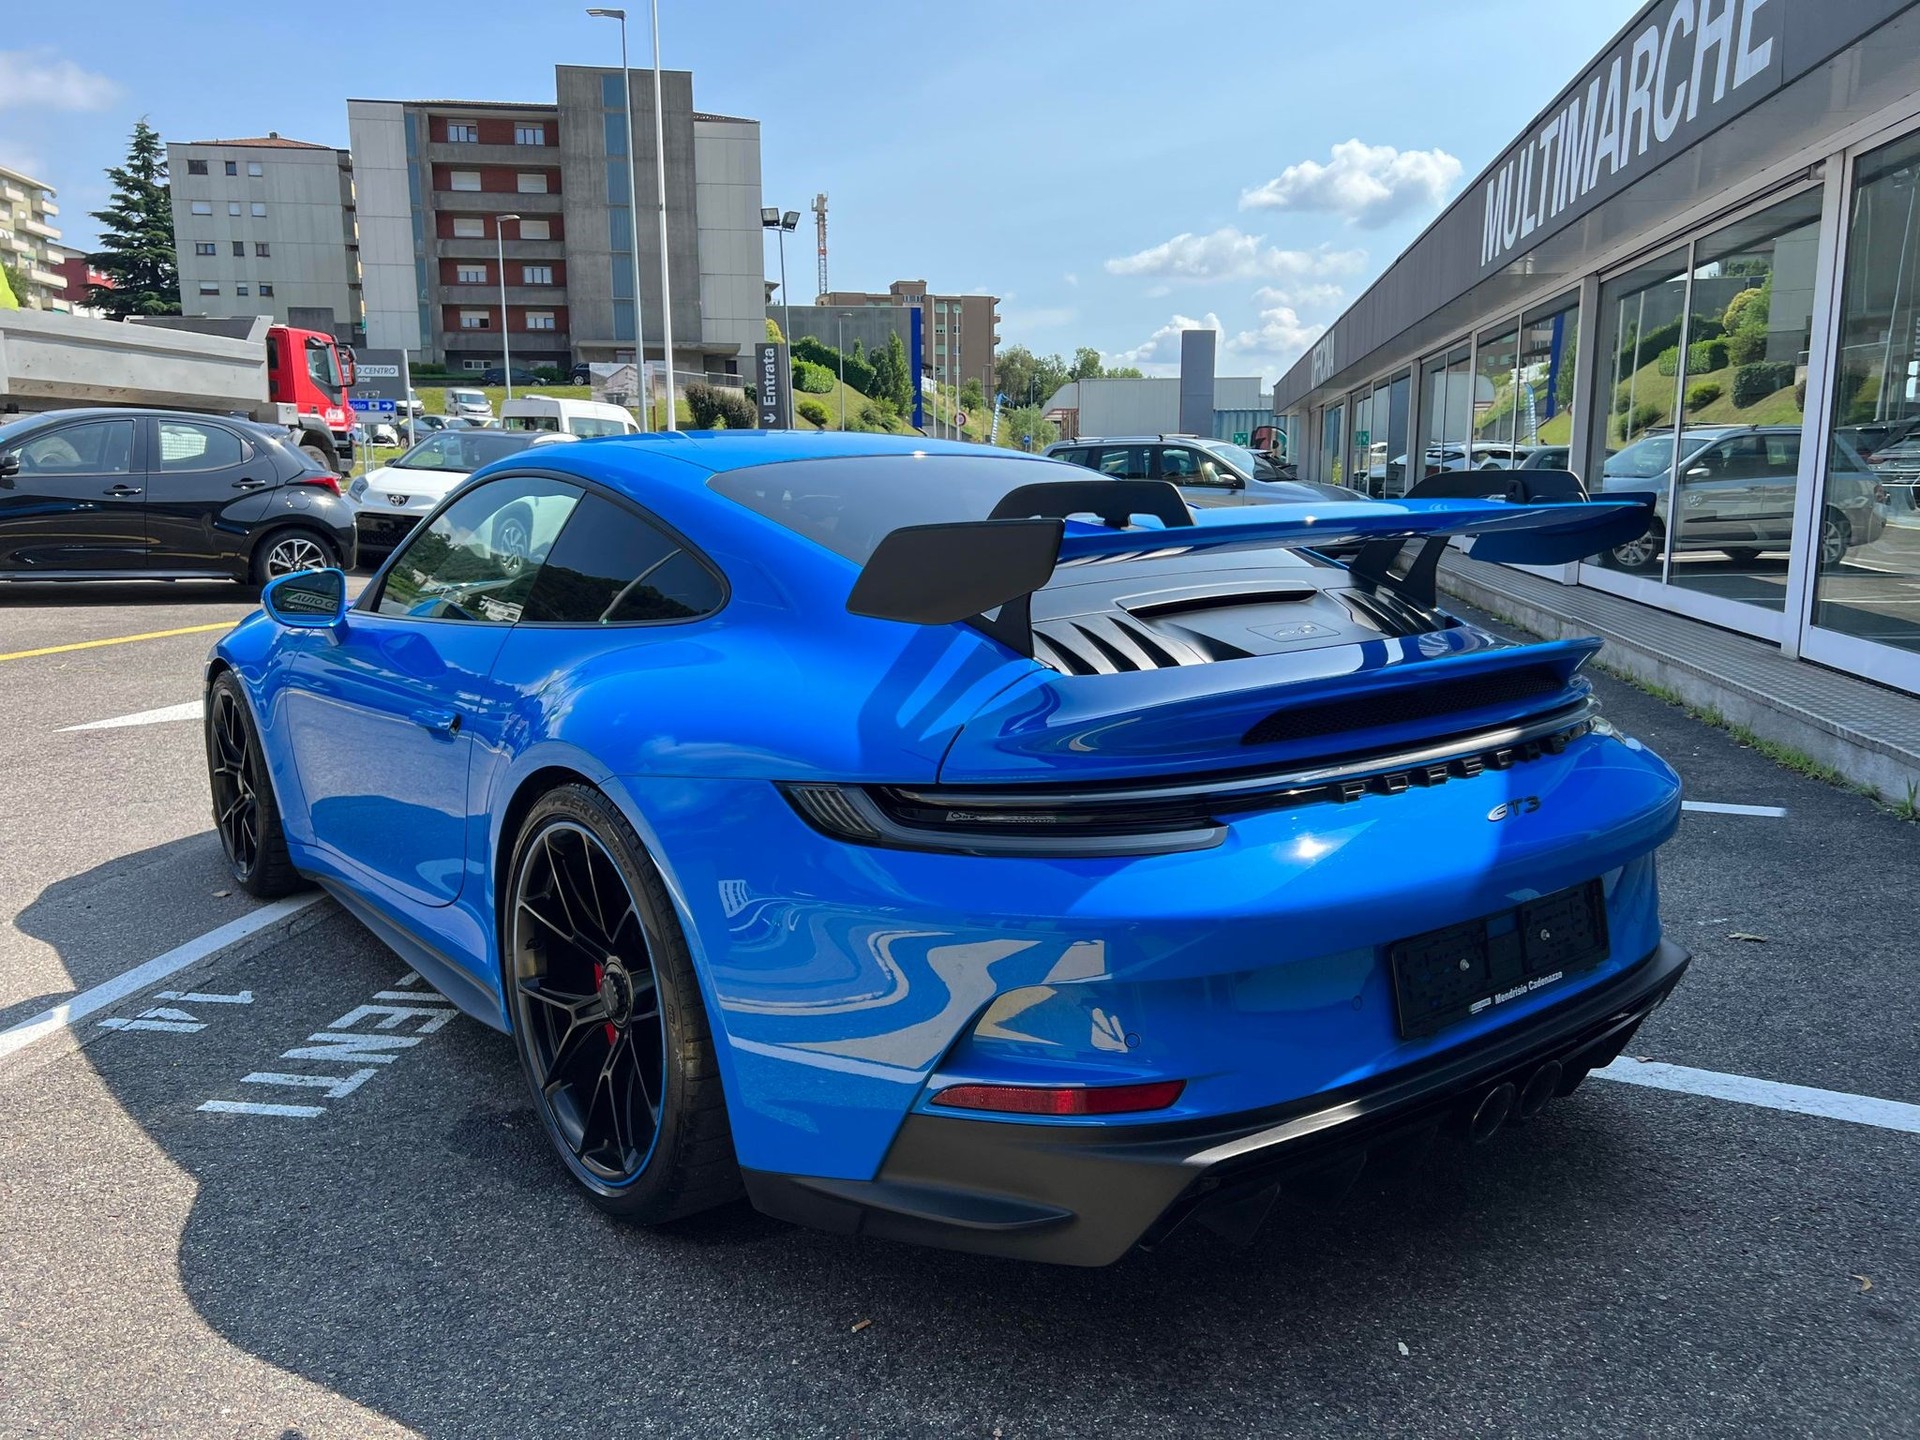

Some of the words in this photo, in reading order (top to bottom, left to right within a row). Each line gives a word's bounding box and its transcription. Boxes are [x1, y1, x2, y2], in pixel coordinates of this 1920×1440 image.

[1480, 0, 1773, 267] MULTIMARCHE
[365, 366, 396, 375] CENTRO
[763, 348, 776, 406] Entrata
[1487, 796, 1539, 822] GT3
[1494, 985, 1527, 1005] Mendrisio
[197, 971, 458, 1118] IENTI
